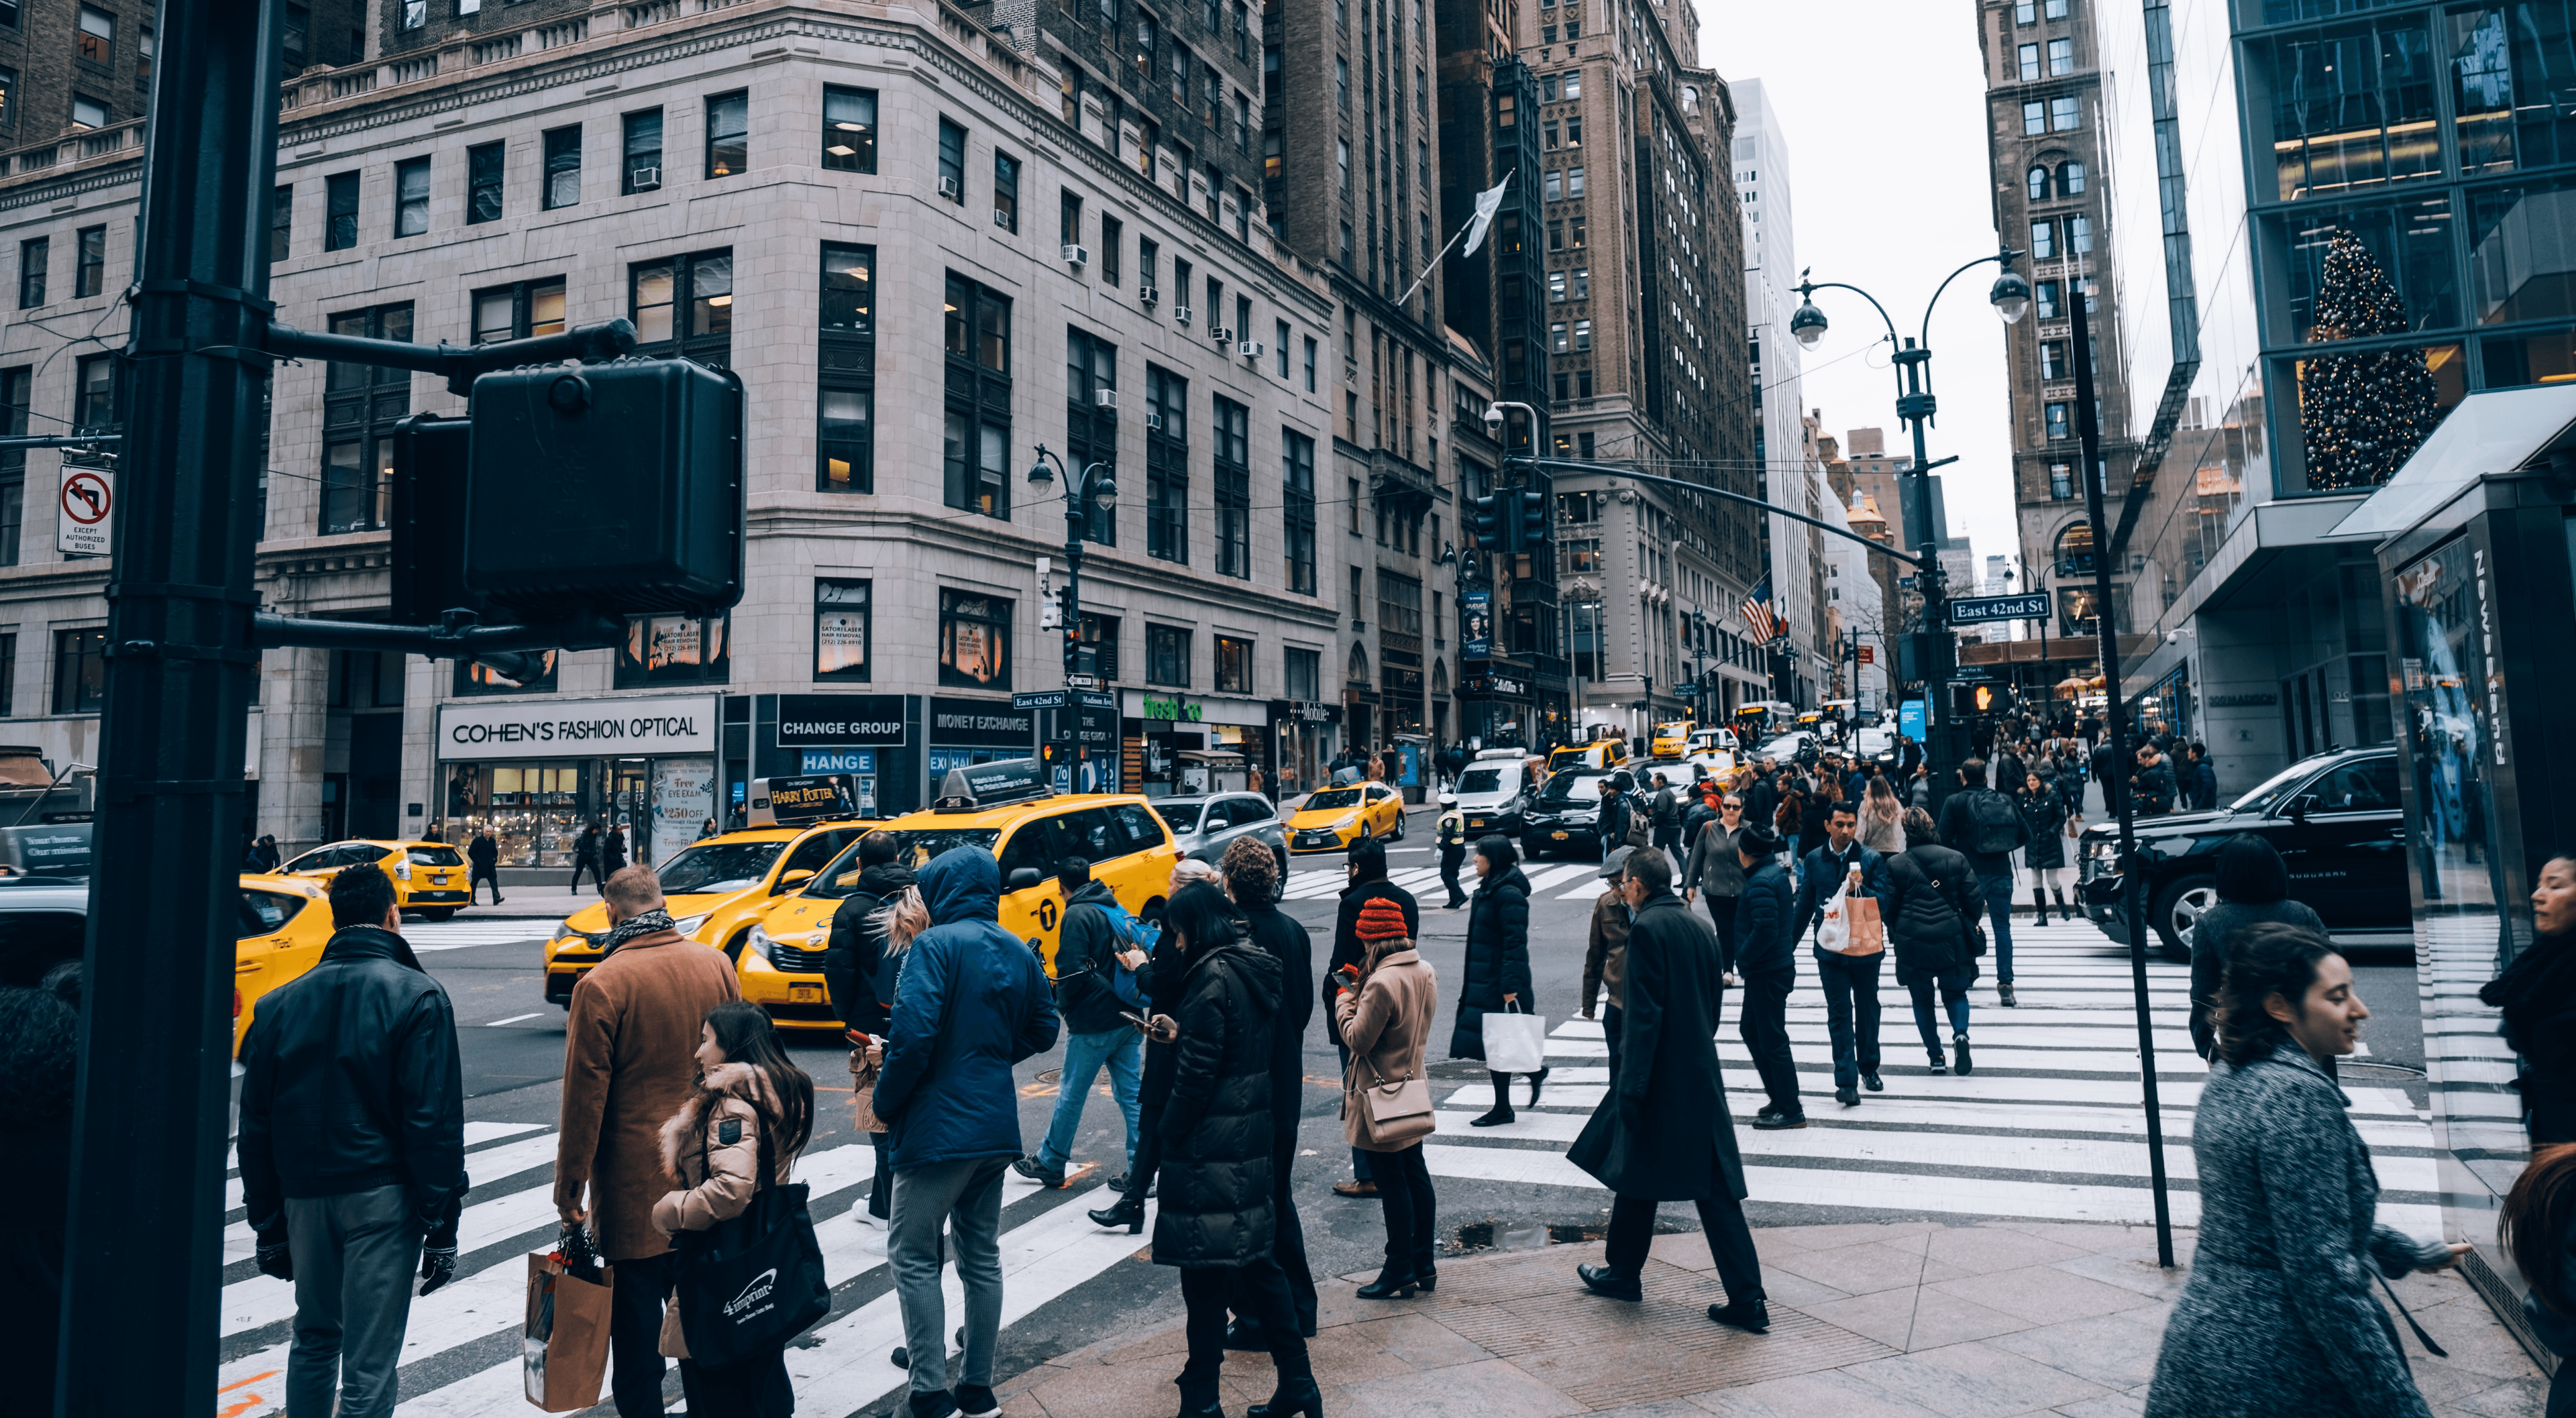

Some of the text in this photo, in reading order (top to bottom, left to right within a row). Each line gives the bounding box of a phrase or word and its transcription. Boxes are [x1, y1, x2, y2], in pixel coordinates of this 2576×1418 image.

[74, 527, 97, 535] EXCEPT
[66, 534, 105, 543] AUTHORIZED
[1957, 600, 2044, 618] East 42nd St
[2474, 549, 2506, 765] Newsstand
[1016, 696, 1062, 706] East 42nd St
[1083, 696, 1112, 706] Madison Ave
[938, 714, 1028, 731] MONEY EXCHANGE
[1082, 716, 1095, 727] THE
[453, 716, 698, 743] COHEN'S FASHION OPTICAL
[783, 722, 901, 734] CHANGE GROUP
[803, 755, 870, 770] HANGE
[951, 757, 969, 769] HA
[674, 778, 695, 788] Free
[682, 789, 701, 798] EXAM
[771, 789, 802, 804] HARRY
[802, 787, 836, 802] POTTER
[665, 807, 704, 818] $250 OFF
[663, 838, 680, 847] Free
[2289, 871, 2347, 879] SUBURBAN
